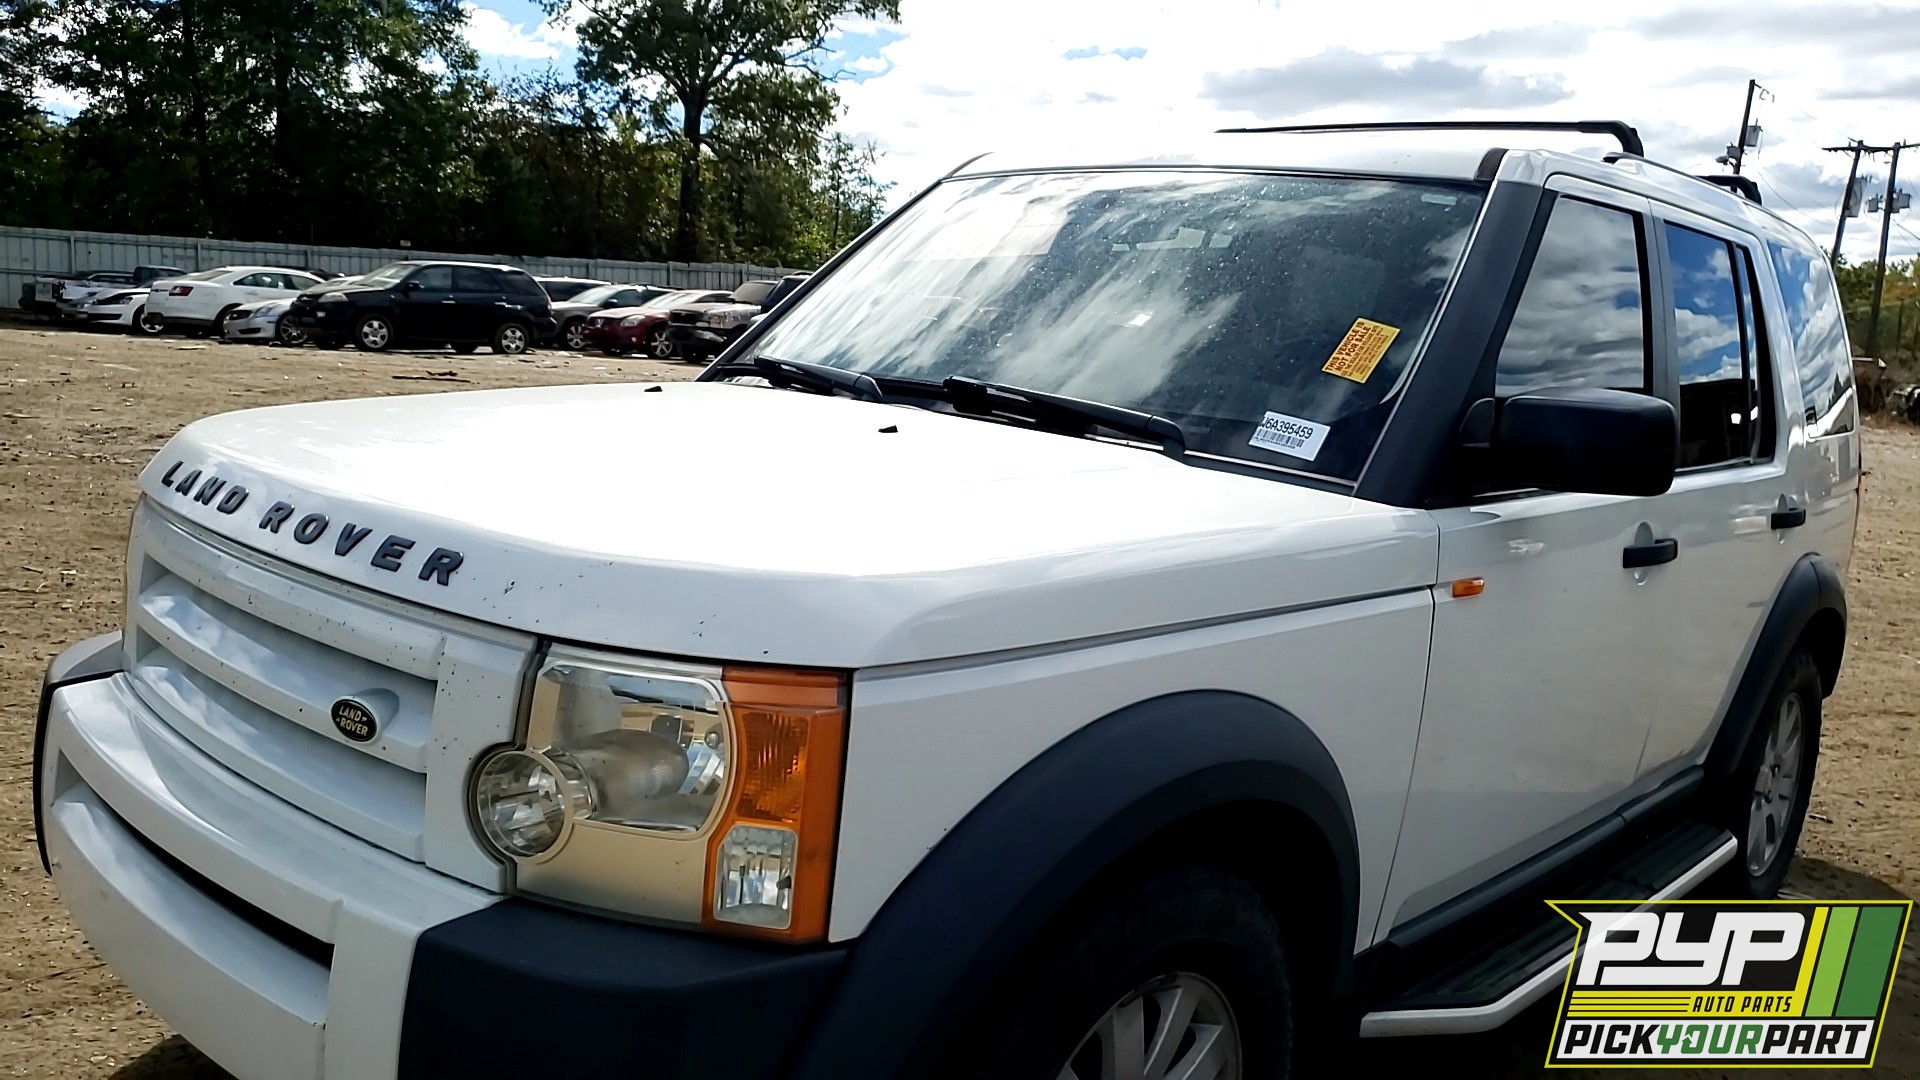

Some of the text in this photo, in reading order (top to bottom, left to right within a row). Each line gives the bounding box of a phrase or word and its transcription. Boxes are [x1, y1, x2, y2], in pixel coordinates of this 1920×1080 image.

[1325, 321, 1365, 371] THIS VEHICLE IS
[1335, 326, 1371, 372] NOT FOR SALE
[161, 461, 465, 587] LAND ROVER
[339, 706, 362, 722] LAND
[340, 717, 368, 737] ROVER
